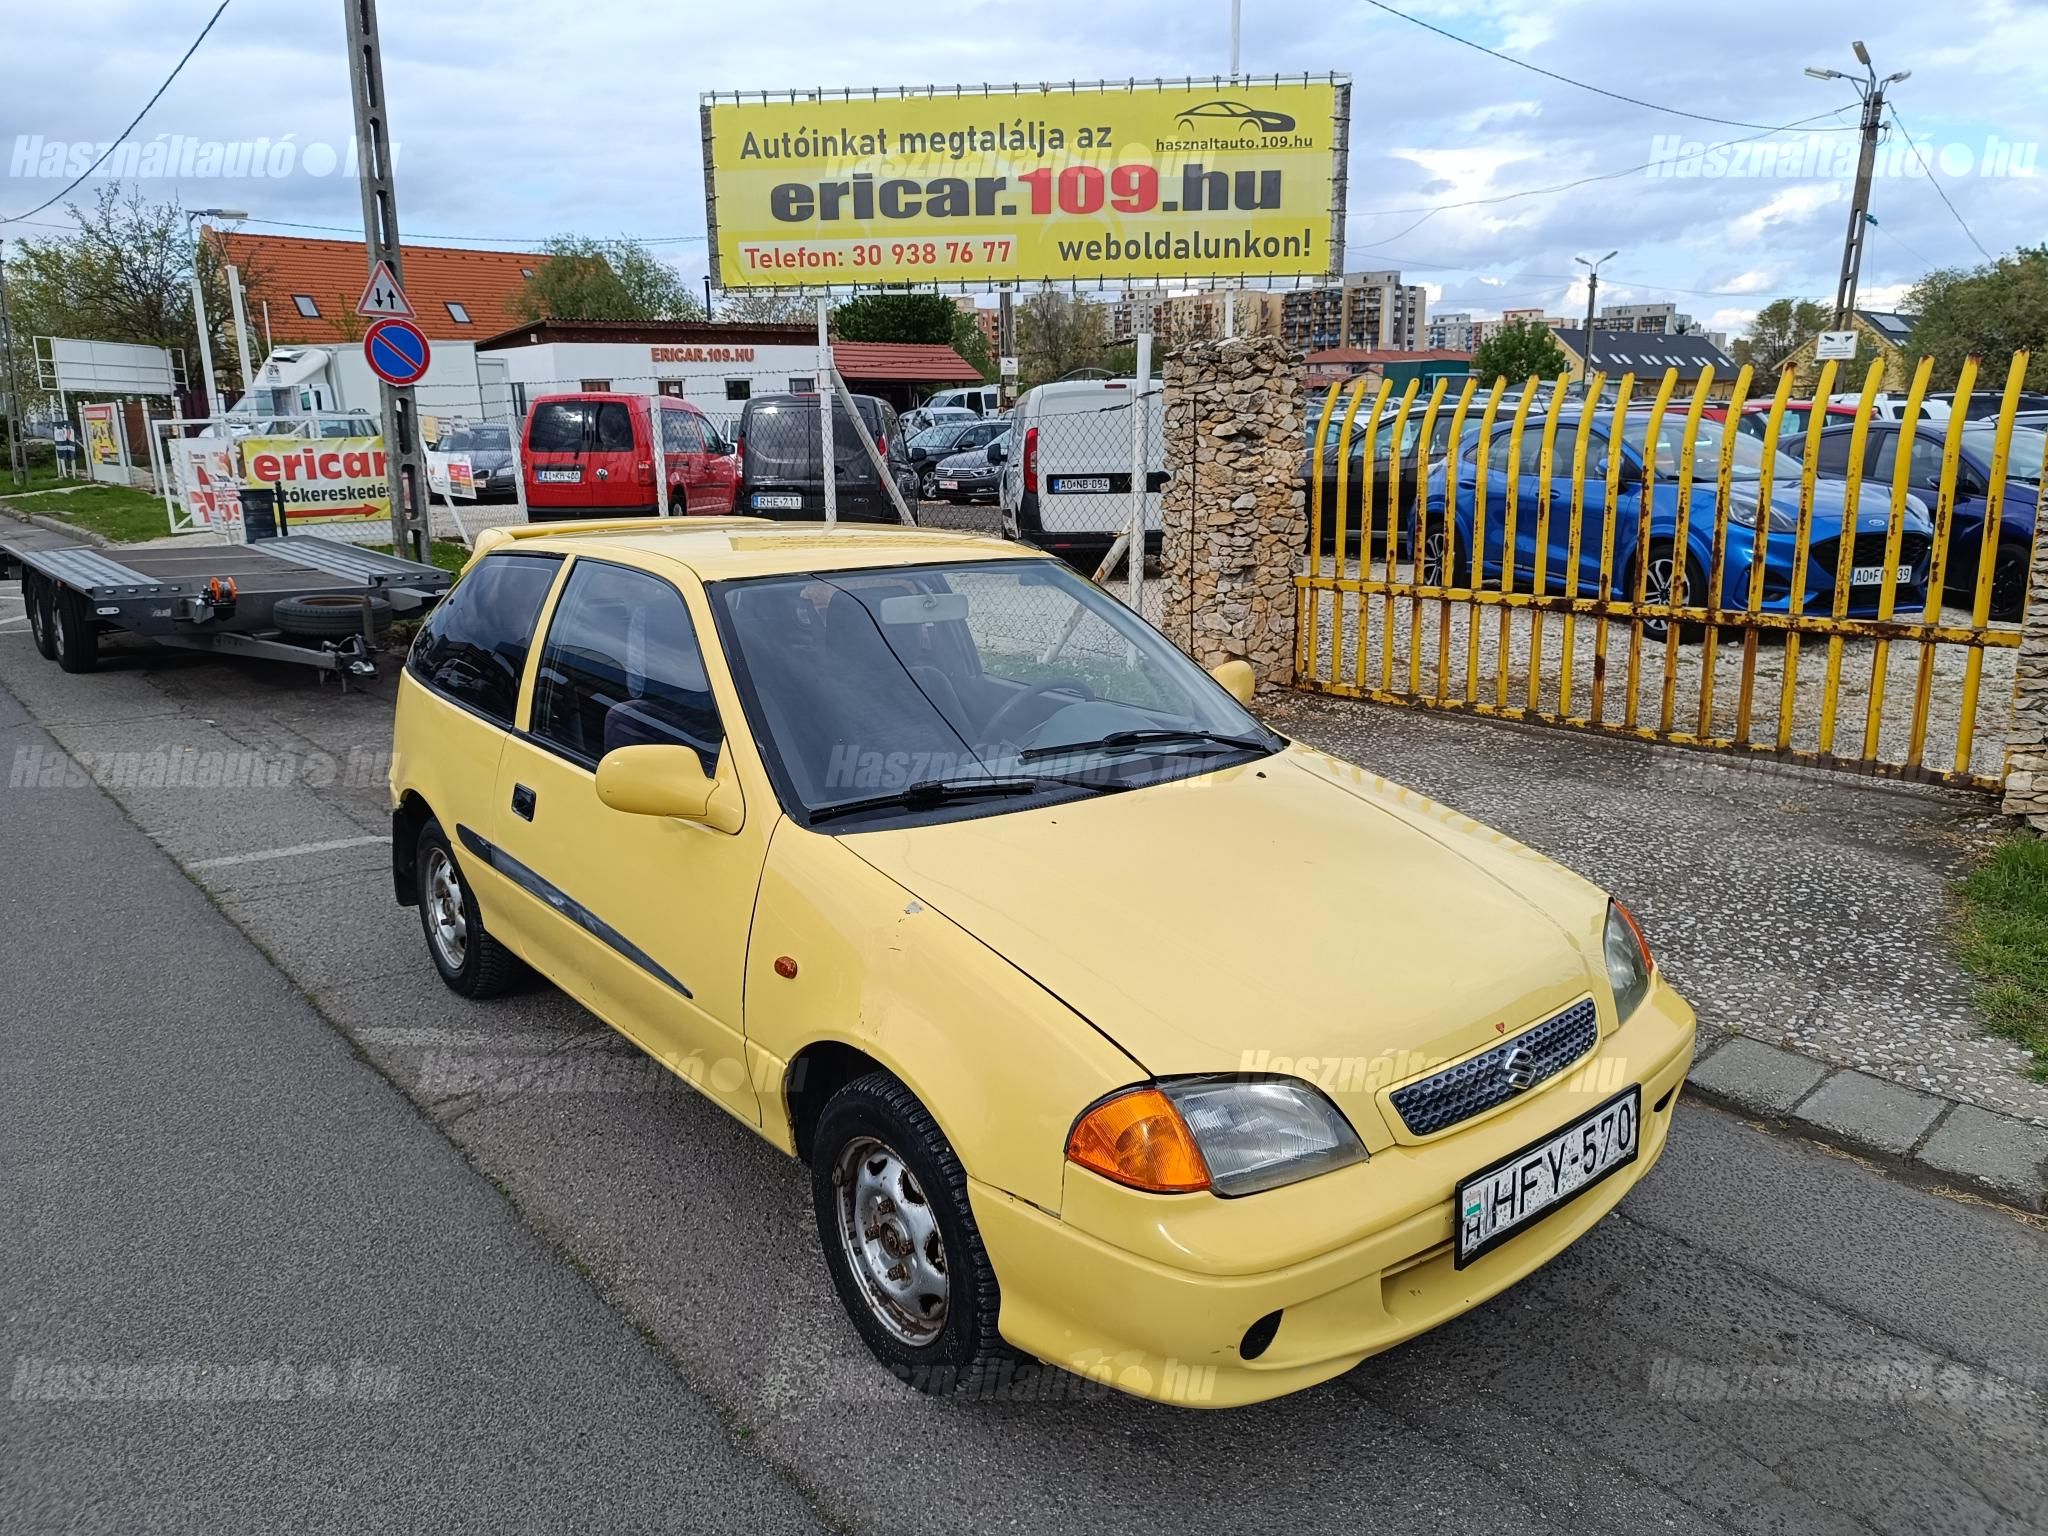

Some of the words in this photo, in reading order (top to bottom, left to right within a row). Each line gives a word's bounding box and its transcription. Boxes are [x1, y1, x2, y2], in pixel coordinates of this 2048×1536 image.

[740, 126, 887, 160] Autóinkat
[899, 118, 1065, 160] megtalálja
[1077, 126, 1112, 149] az
[1156, 135, 1313, 151] hasznaltauto.109.hu
[770, 163, 1282, 223] ericar.109.hu
[744, 247, 844, 269] Telefon:
[852, 245, 882, 266] 30
[891, 243, 937, 264] 938
[946, 241, 974, 263] 76
[983, 240, 1011, 262] 77
[1058, 228, 1311, 262] weboldalunkon!
[651, 347, 755, 363] ERICAR.109.HU
[253, 448, 389, 482] ericar
[272, 482, 391, 504] tókereskedé
[1491, 1103, 1632, 1229] HFY-570
